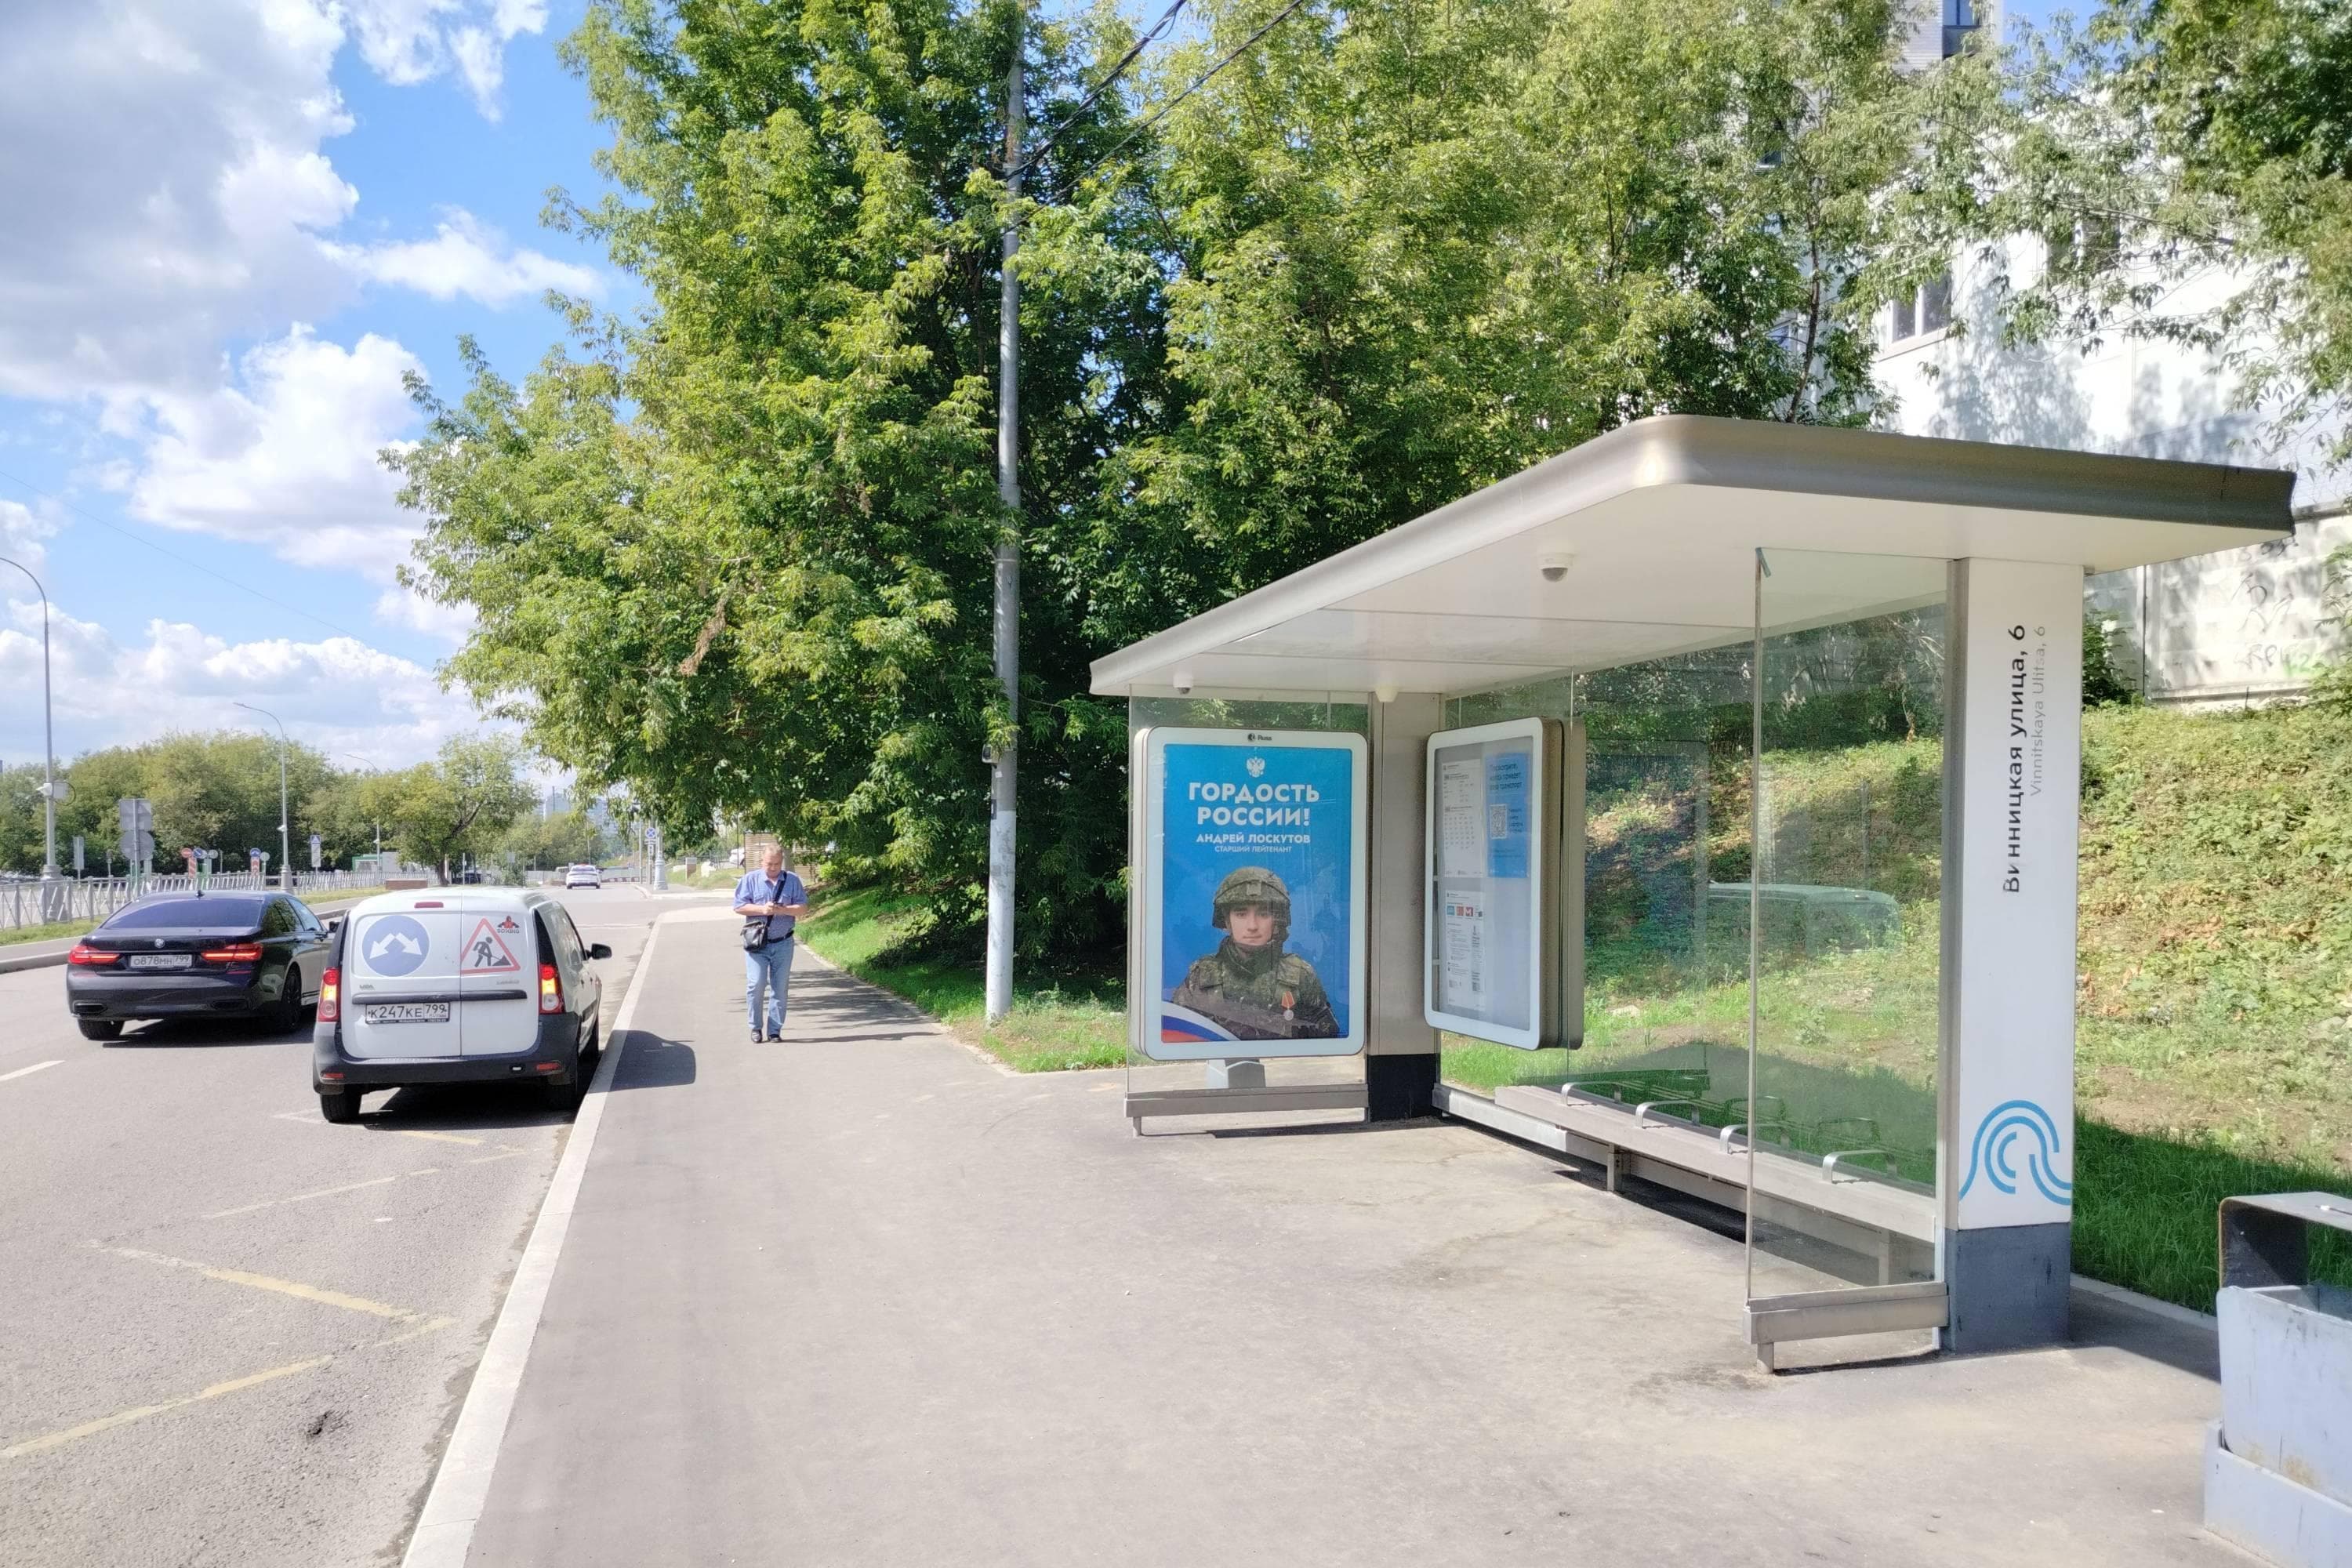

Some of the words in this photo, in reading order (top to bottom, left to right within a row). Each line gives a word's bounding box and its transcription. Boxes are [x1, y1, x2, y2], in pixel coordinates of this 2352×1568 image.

[2008, 624, 2026, 641] 6
[2034, 626, 2045, 637] 6
[2032, 643, 2047, 695] Ulitsa,
[2010, 650, 2028, 739] улица,
[2031, 701, 2046, 797] Vinnitskaya
[1189, 782, 1320, 804] ГОРДОСТЬ
[1197, 807, 1311, 826] РОССИИ!
[1196, 831, 1245, 844] АНДРЕЙ
[1247, 833, 1312, 844] ЛОСКУТОВ
[1252, 844, 1292, 853] ЛЕЙТЕНАНТ
